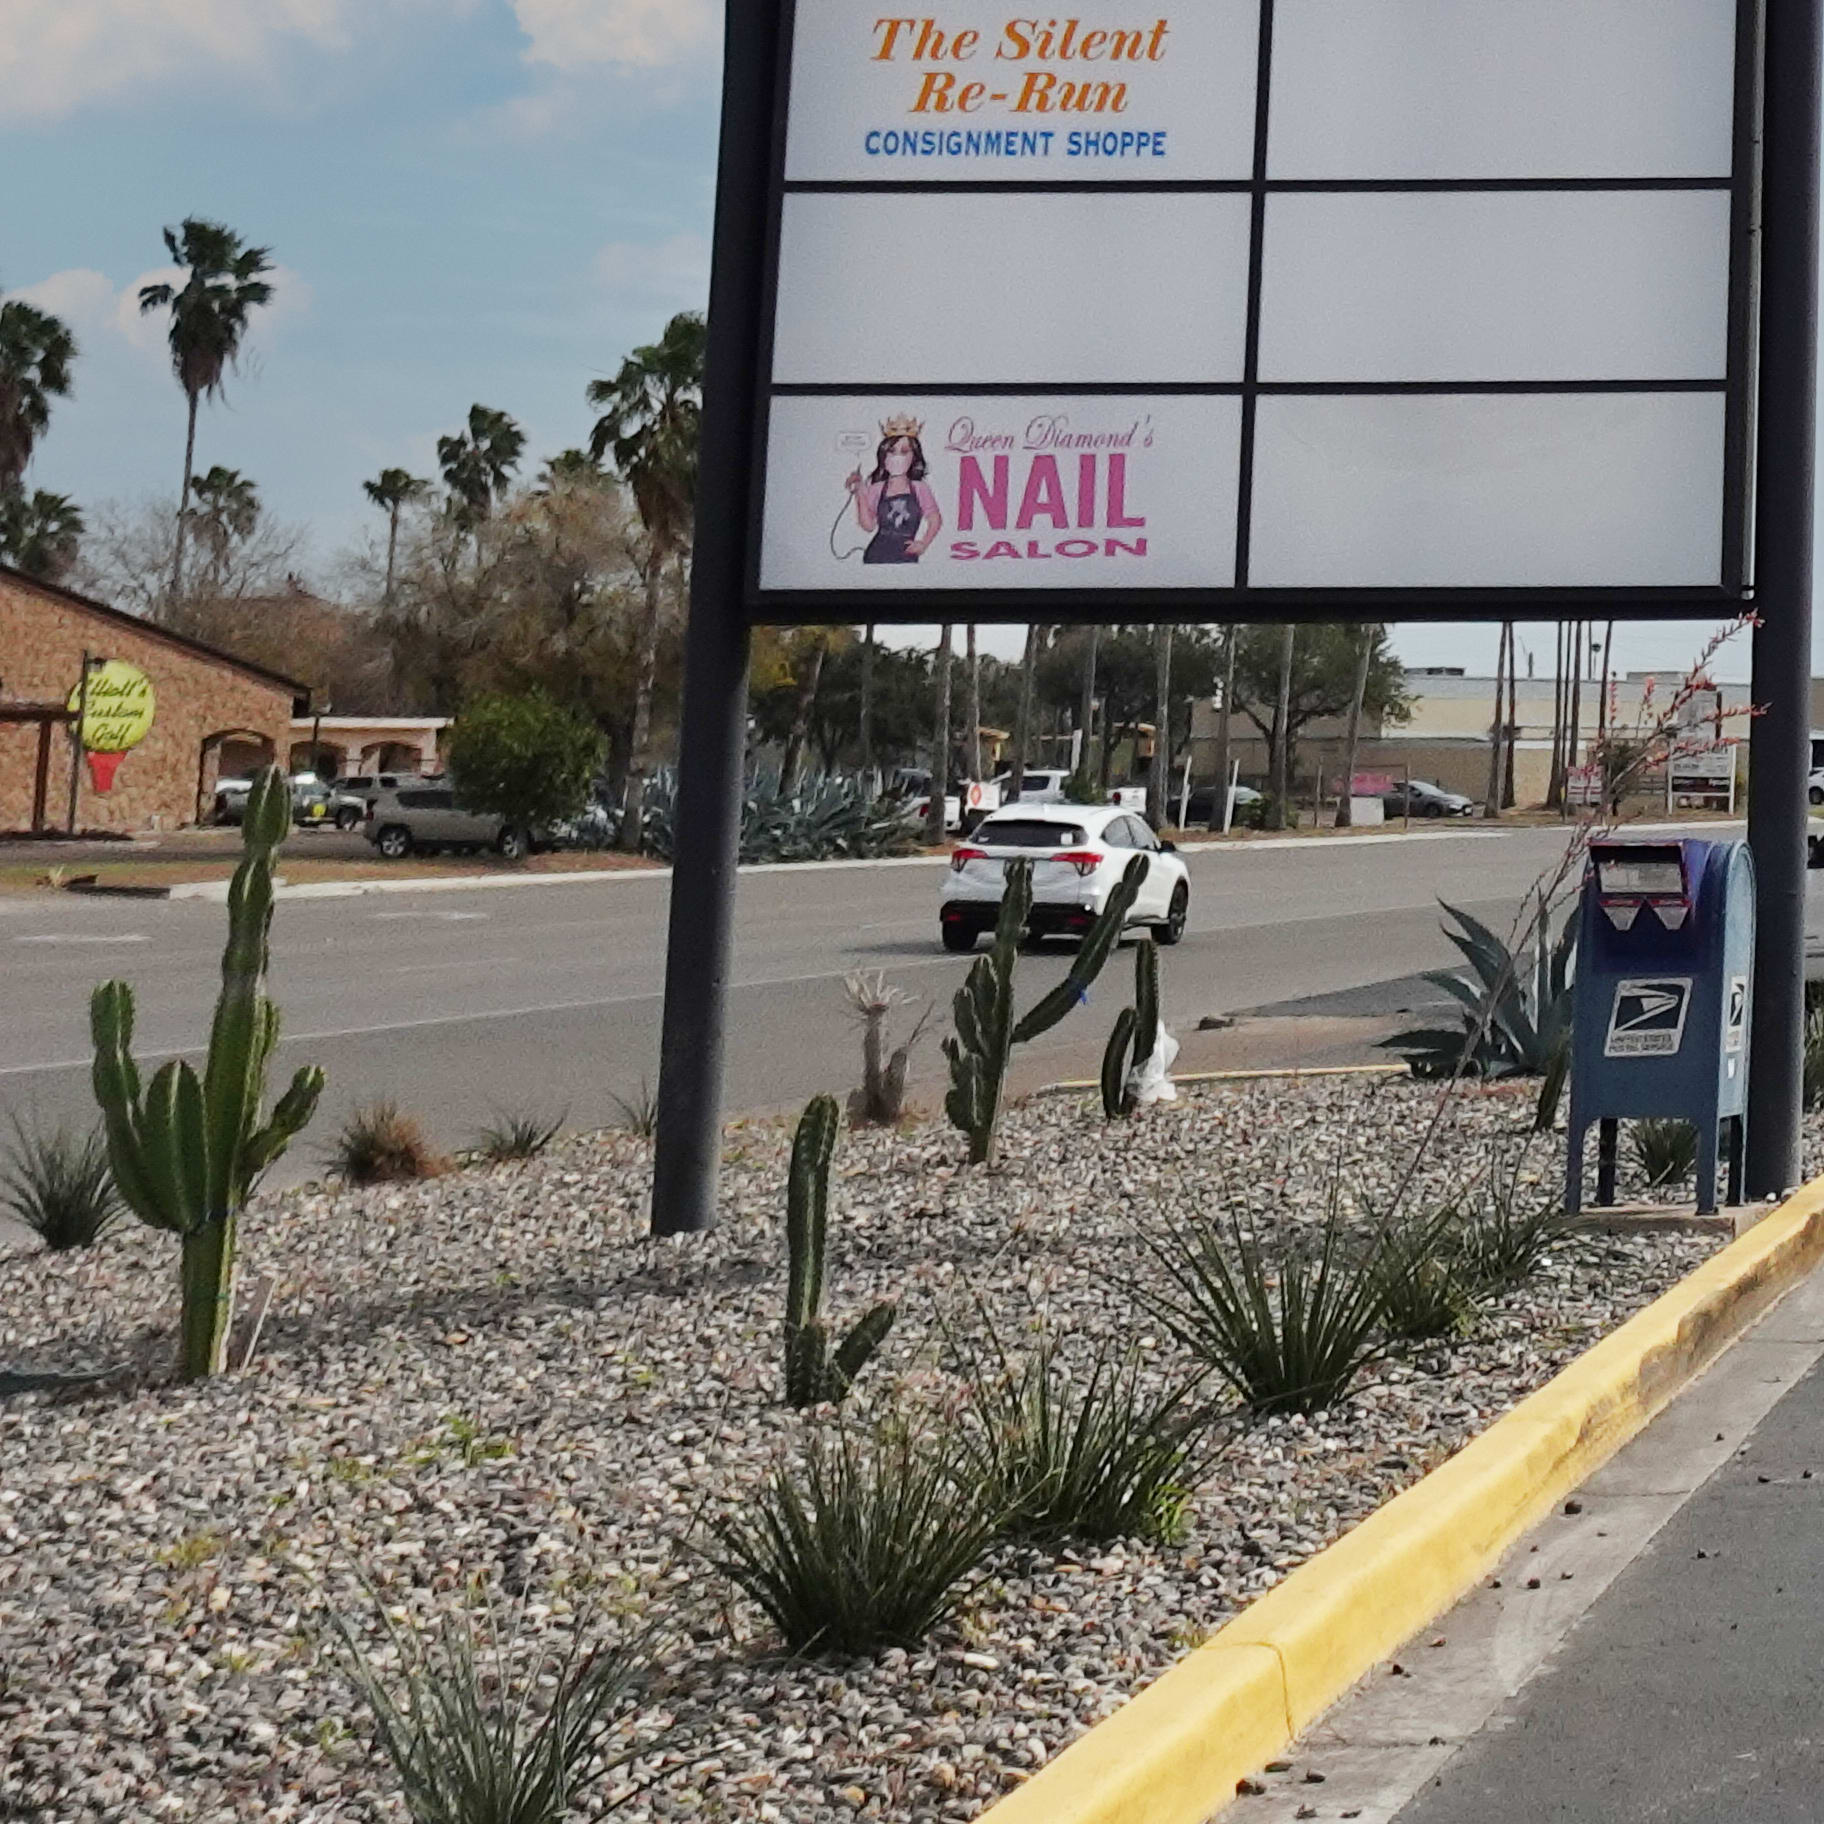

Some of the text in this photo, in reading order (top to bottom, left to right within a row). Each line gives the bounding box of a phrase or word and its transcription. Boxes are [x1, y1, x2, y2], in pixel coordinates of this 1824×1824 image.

[870, 18, 1172, 61] The Silent
[907, 72, 1128, 113] Re-Run
[864, 130, 1168, 158] CONSIGNMENT SHOPPE
[945, 414, 1154, 453] Queen Diamond's
[957, 453, 1146, 530] NAIL
[950, 538, 1147, 561] SALON
